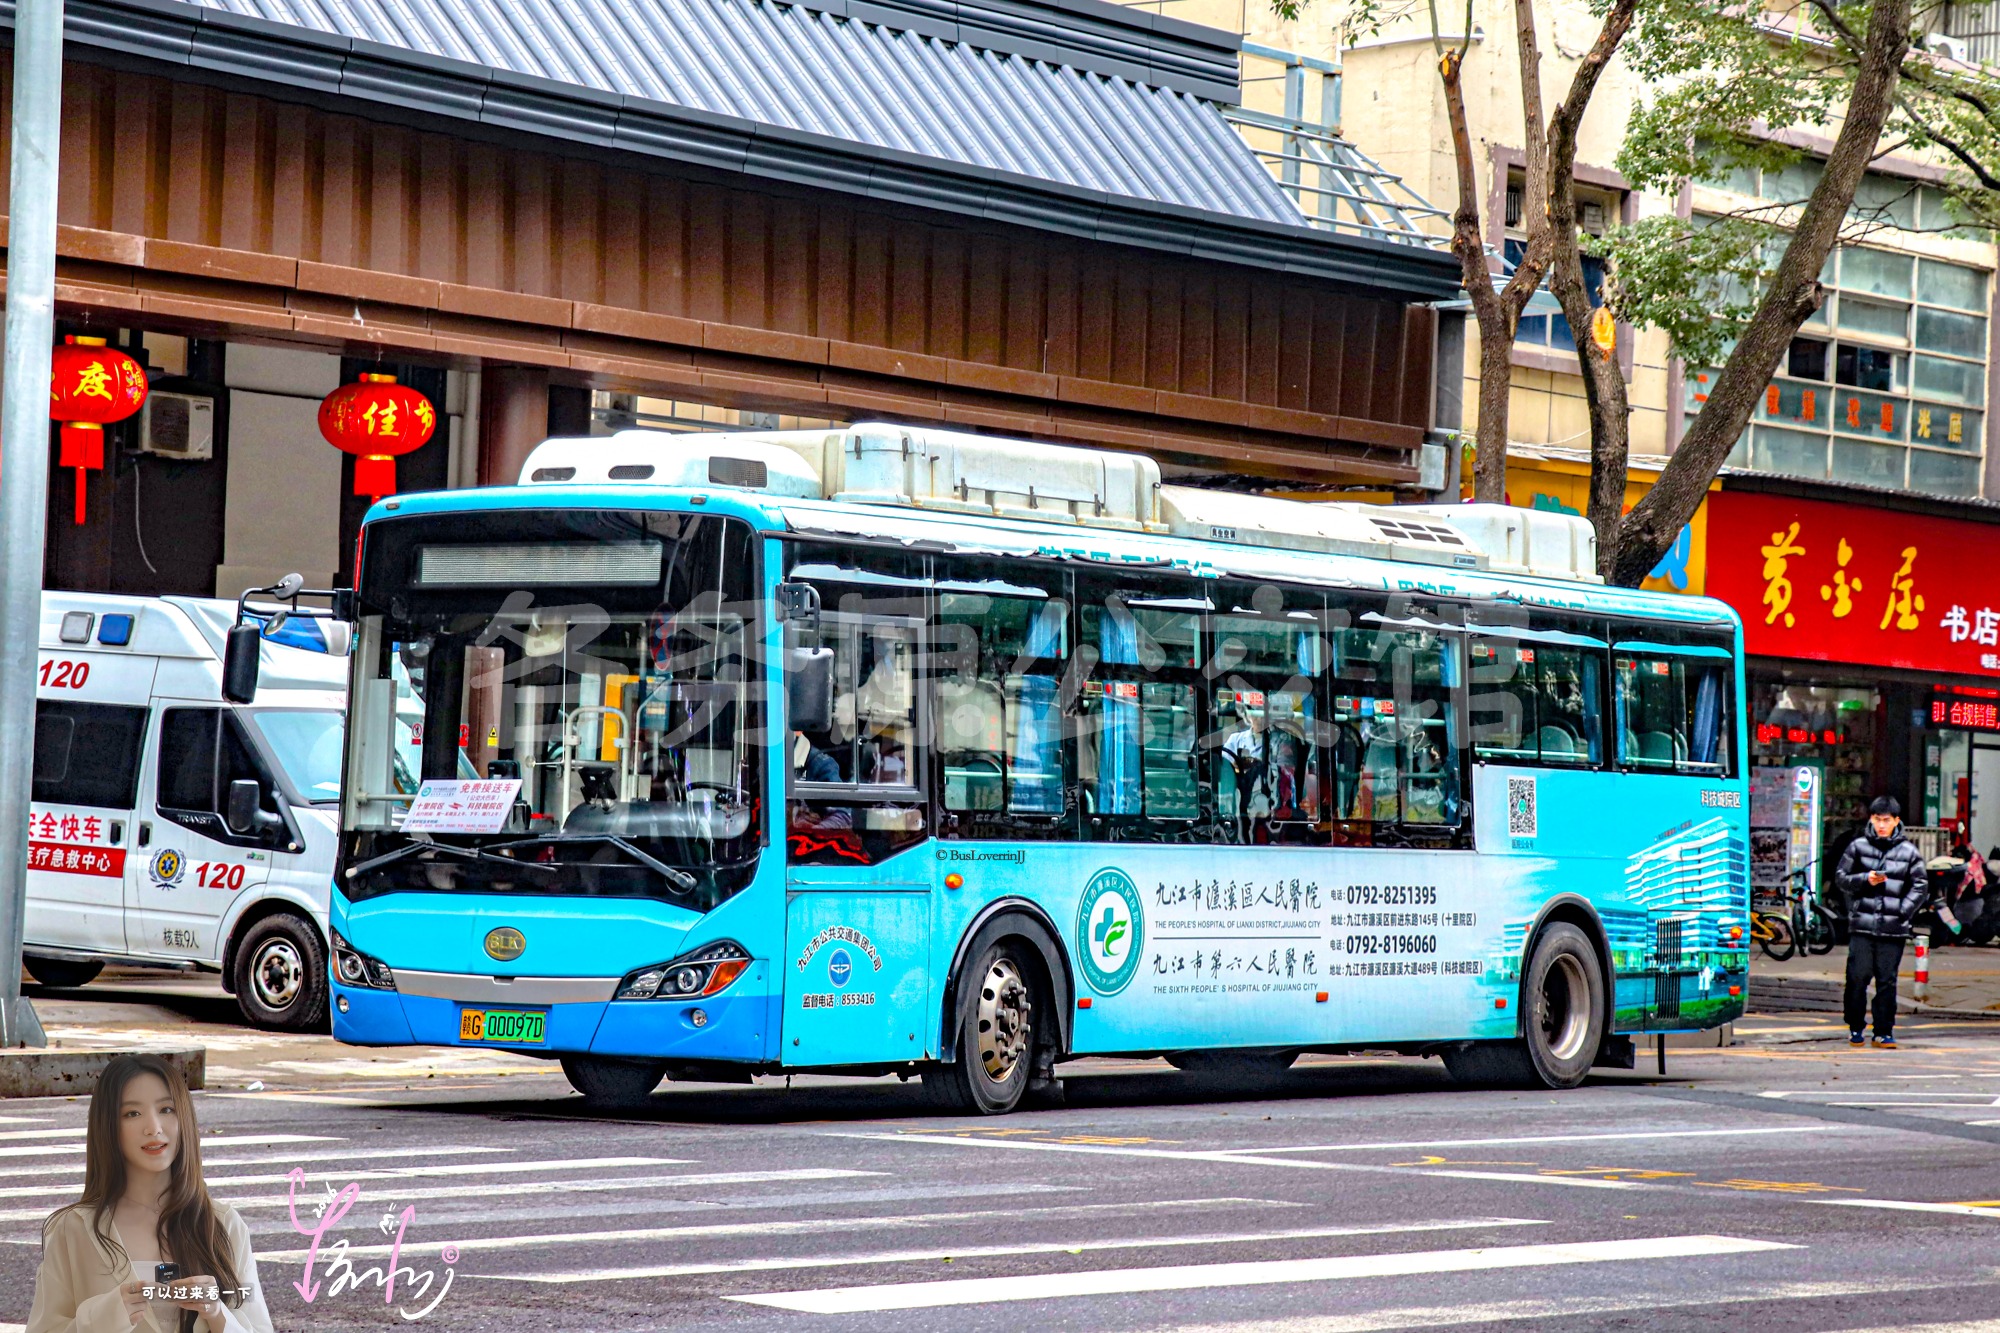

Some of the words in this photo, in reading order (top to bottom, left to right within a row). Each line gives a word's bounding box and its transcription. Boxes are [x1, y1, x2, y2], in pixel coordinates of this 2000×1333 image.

[362, 398, 434, 437] 佳节
[1761, 521, 1925, 631] 黄金屋
[1939, 604, 2000, 647] 书店
[39, 659, 90, 690] 120
[460, 783, 514, 794] 免费接送车
[1701, 789, 1742, 808] 科技城院区
[178, 814, 213, 825] TRANSIT
[195, 861, 246, 890] 120
[163, 928, 199, 948] 核载9人
[1153, 986, 1167, 994] THE
[1168, 985, 1189, 993] SIXTH
[1228, 984, 1260, 992] HOSPITAL
[1273, 983, 1301, 991] JIUJIANG
[1303, 983, 1318, 991] CITY
